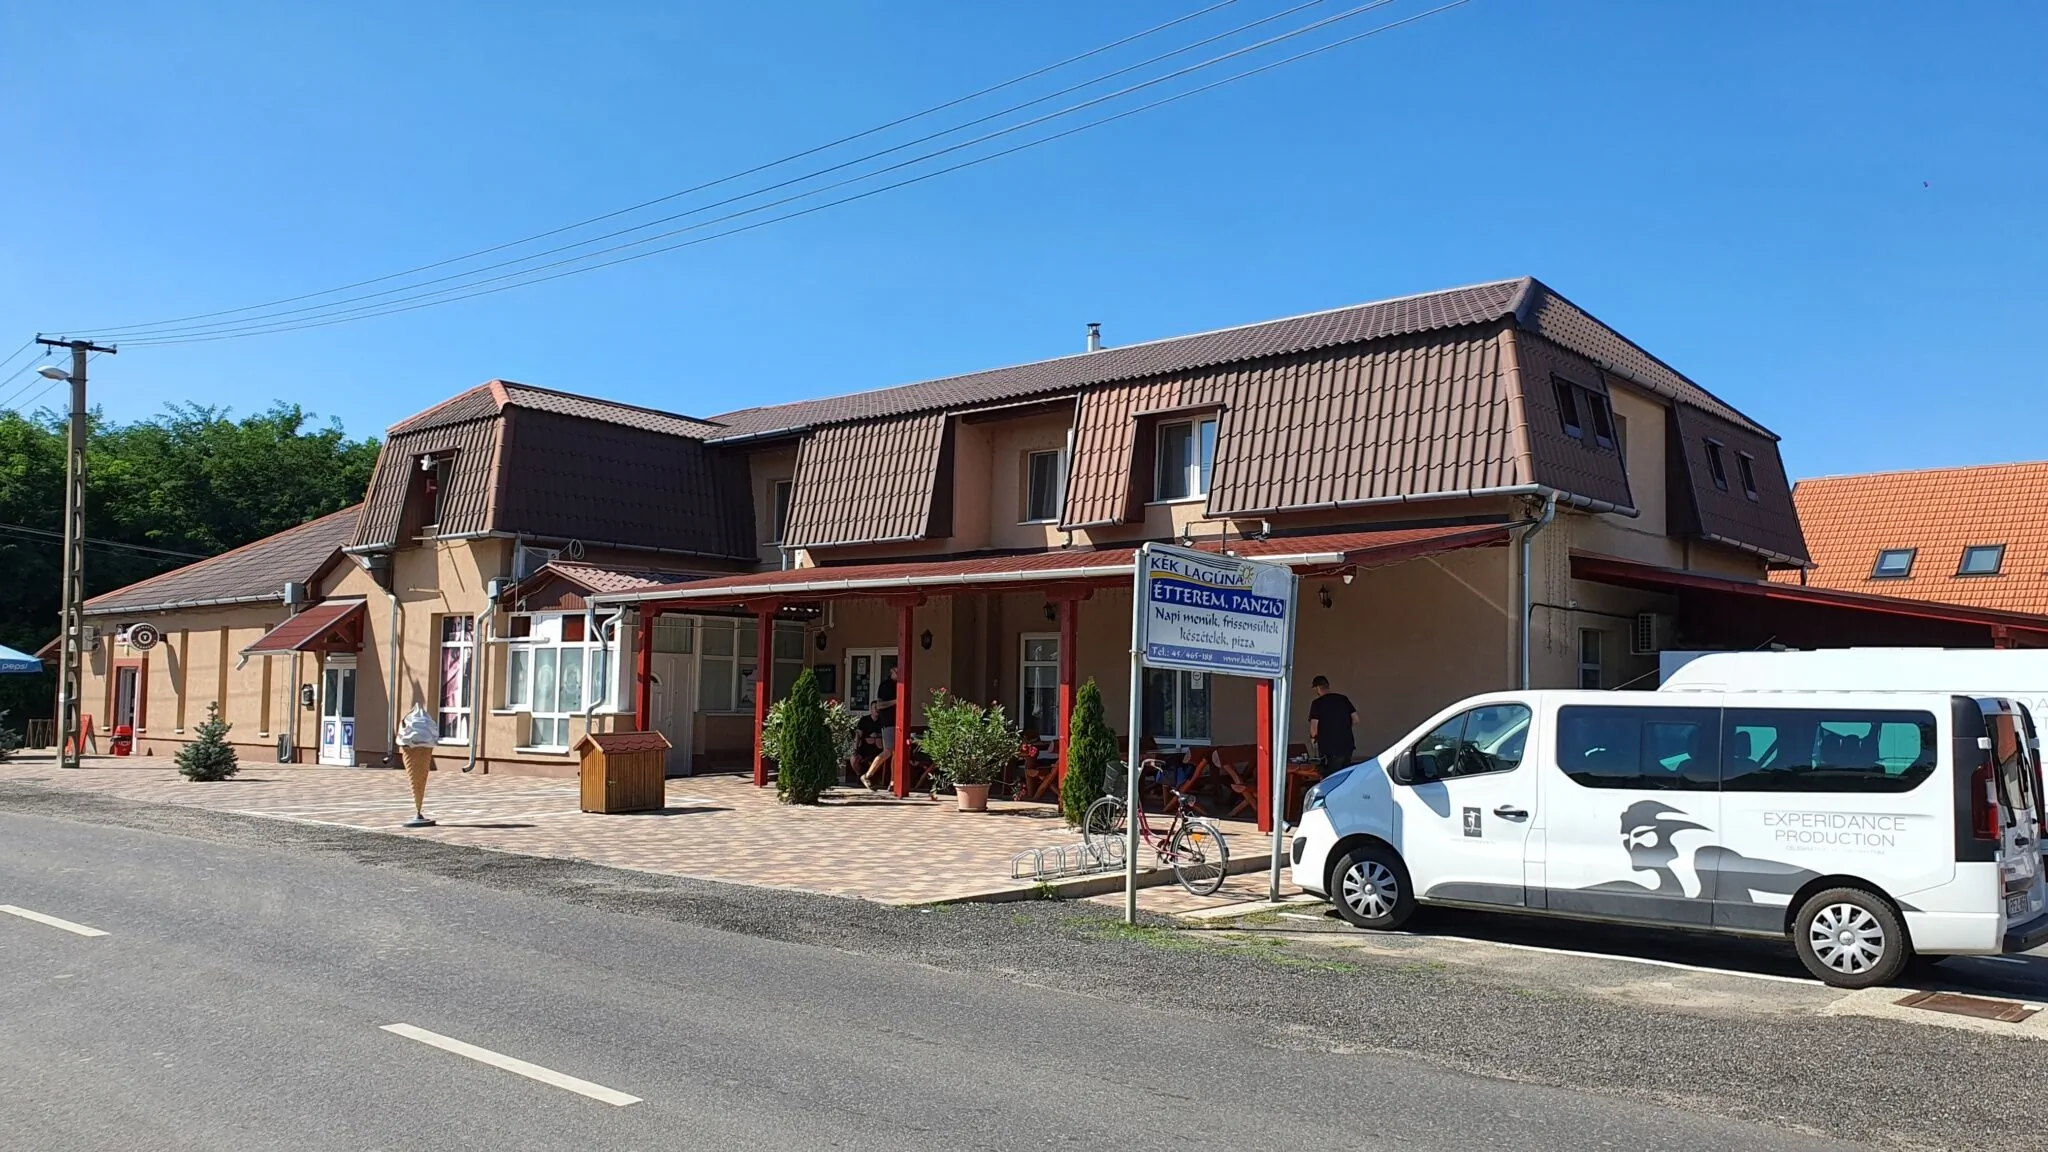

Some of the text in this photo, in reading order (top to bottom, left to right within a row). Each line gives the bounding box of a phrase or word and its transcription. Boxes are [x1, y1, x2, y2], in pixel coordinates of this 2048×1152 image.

[1151, 555, 1244, 585] KÉK LAGÚNA
[1232, 595, 1283, 615] PANZIÓ
[1155, 606, 1180, 624] Napi
[1222, 614, 1278, 634] frissensültek
[1232, 635, 1256, 649] pizza
[2, 662, 28, 671] pepsi
[1763, 811, 1907, 832] EXPERIDANCE
[1775, 829, 1895, 848] PRODUCTION
